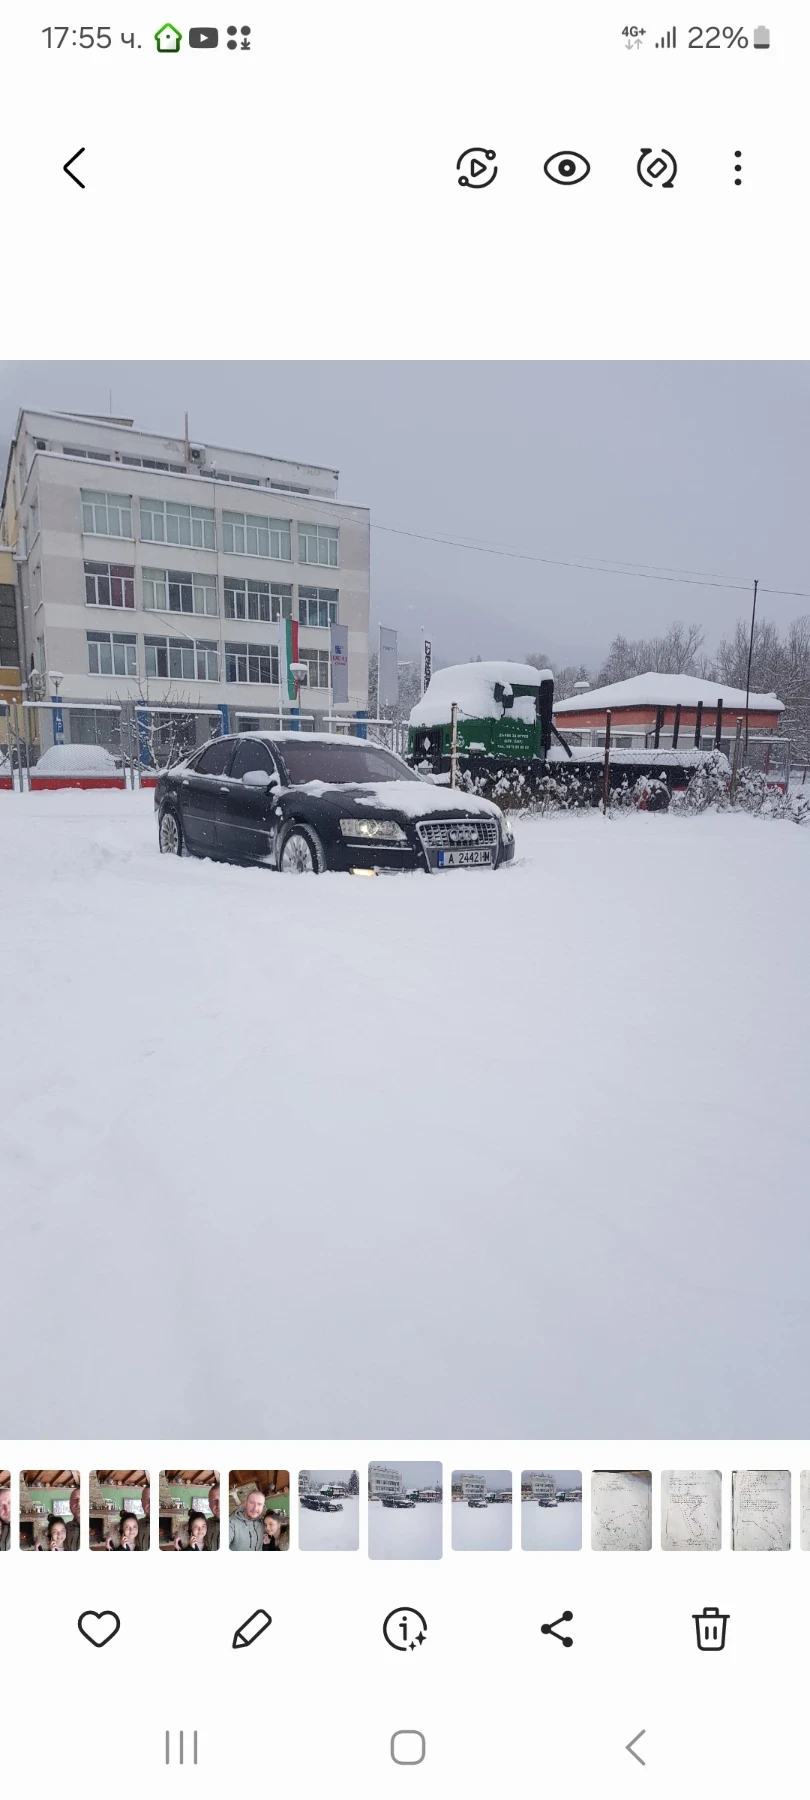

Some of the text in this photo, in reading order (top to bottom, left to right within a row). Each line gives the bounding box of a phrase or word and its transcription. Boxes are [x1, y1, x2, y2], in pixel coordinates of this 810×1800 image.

[41, 26, 142, 49] 17:55 ч.
[621, 25, 647, 37] 4G+
[688, 26, 749, 49] 22%
